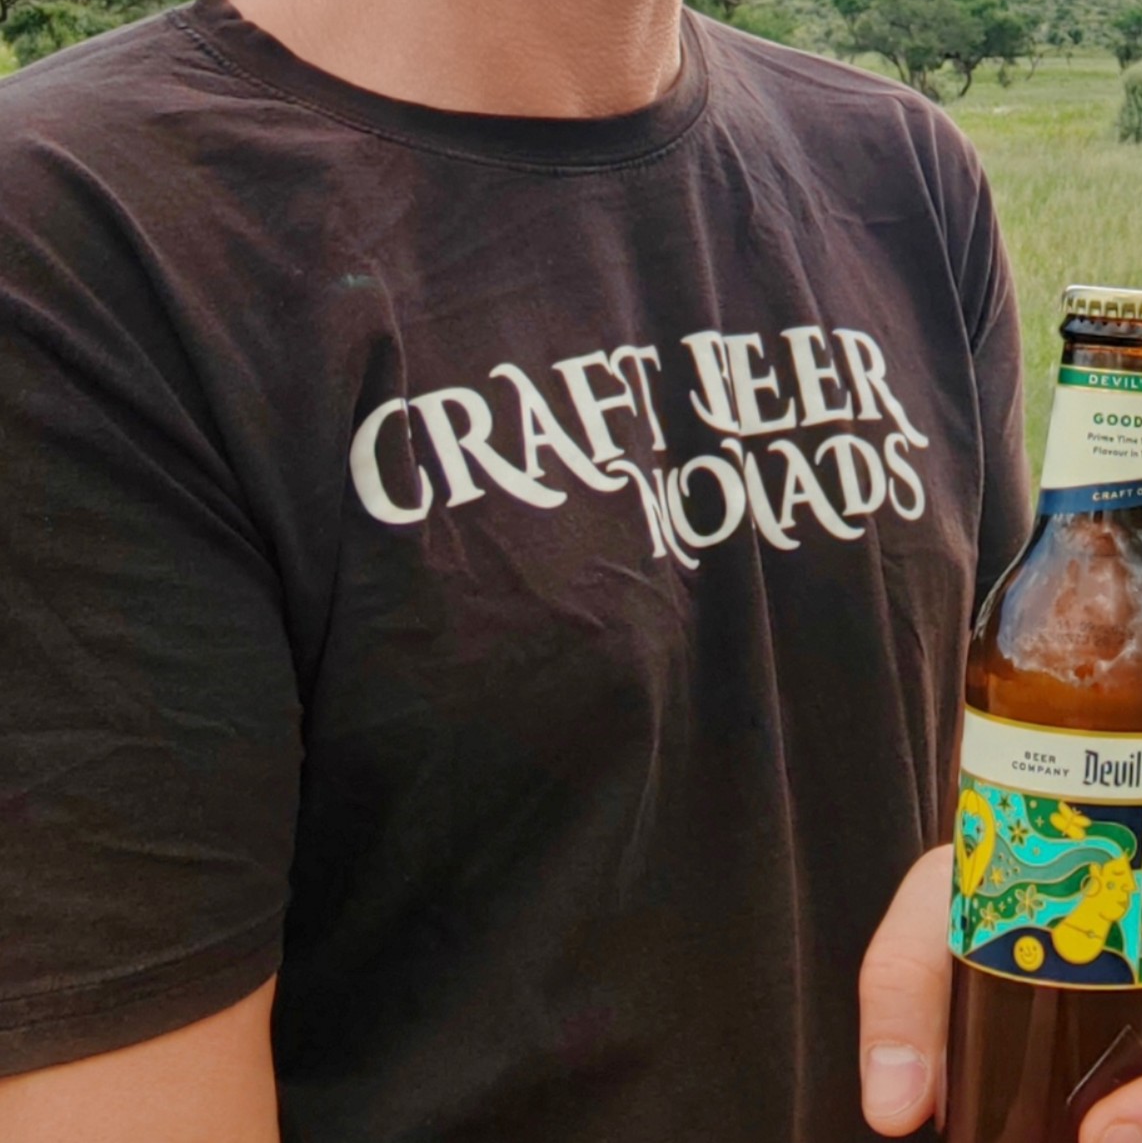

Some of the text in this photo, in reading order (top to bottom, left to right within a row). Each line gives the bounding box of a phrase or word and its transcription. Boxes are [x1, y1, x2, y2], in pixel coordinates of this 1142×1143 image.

[350, 344, 661, 524] CRAFT
[1092, 488, 1134, 502] CRAFT
[1024, 751, 1056, 764] BEER
[1011, 760, 1070, 778] COMPANY
